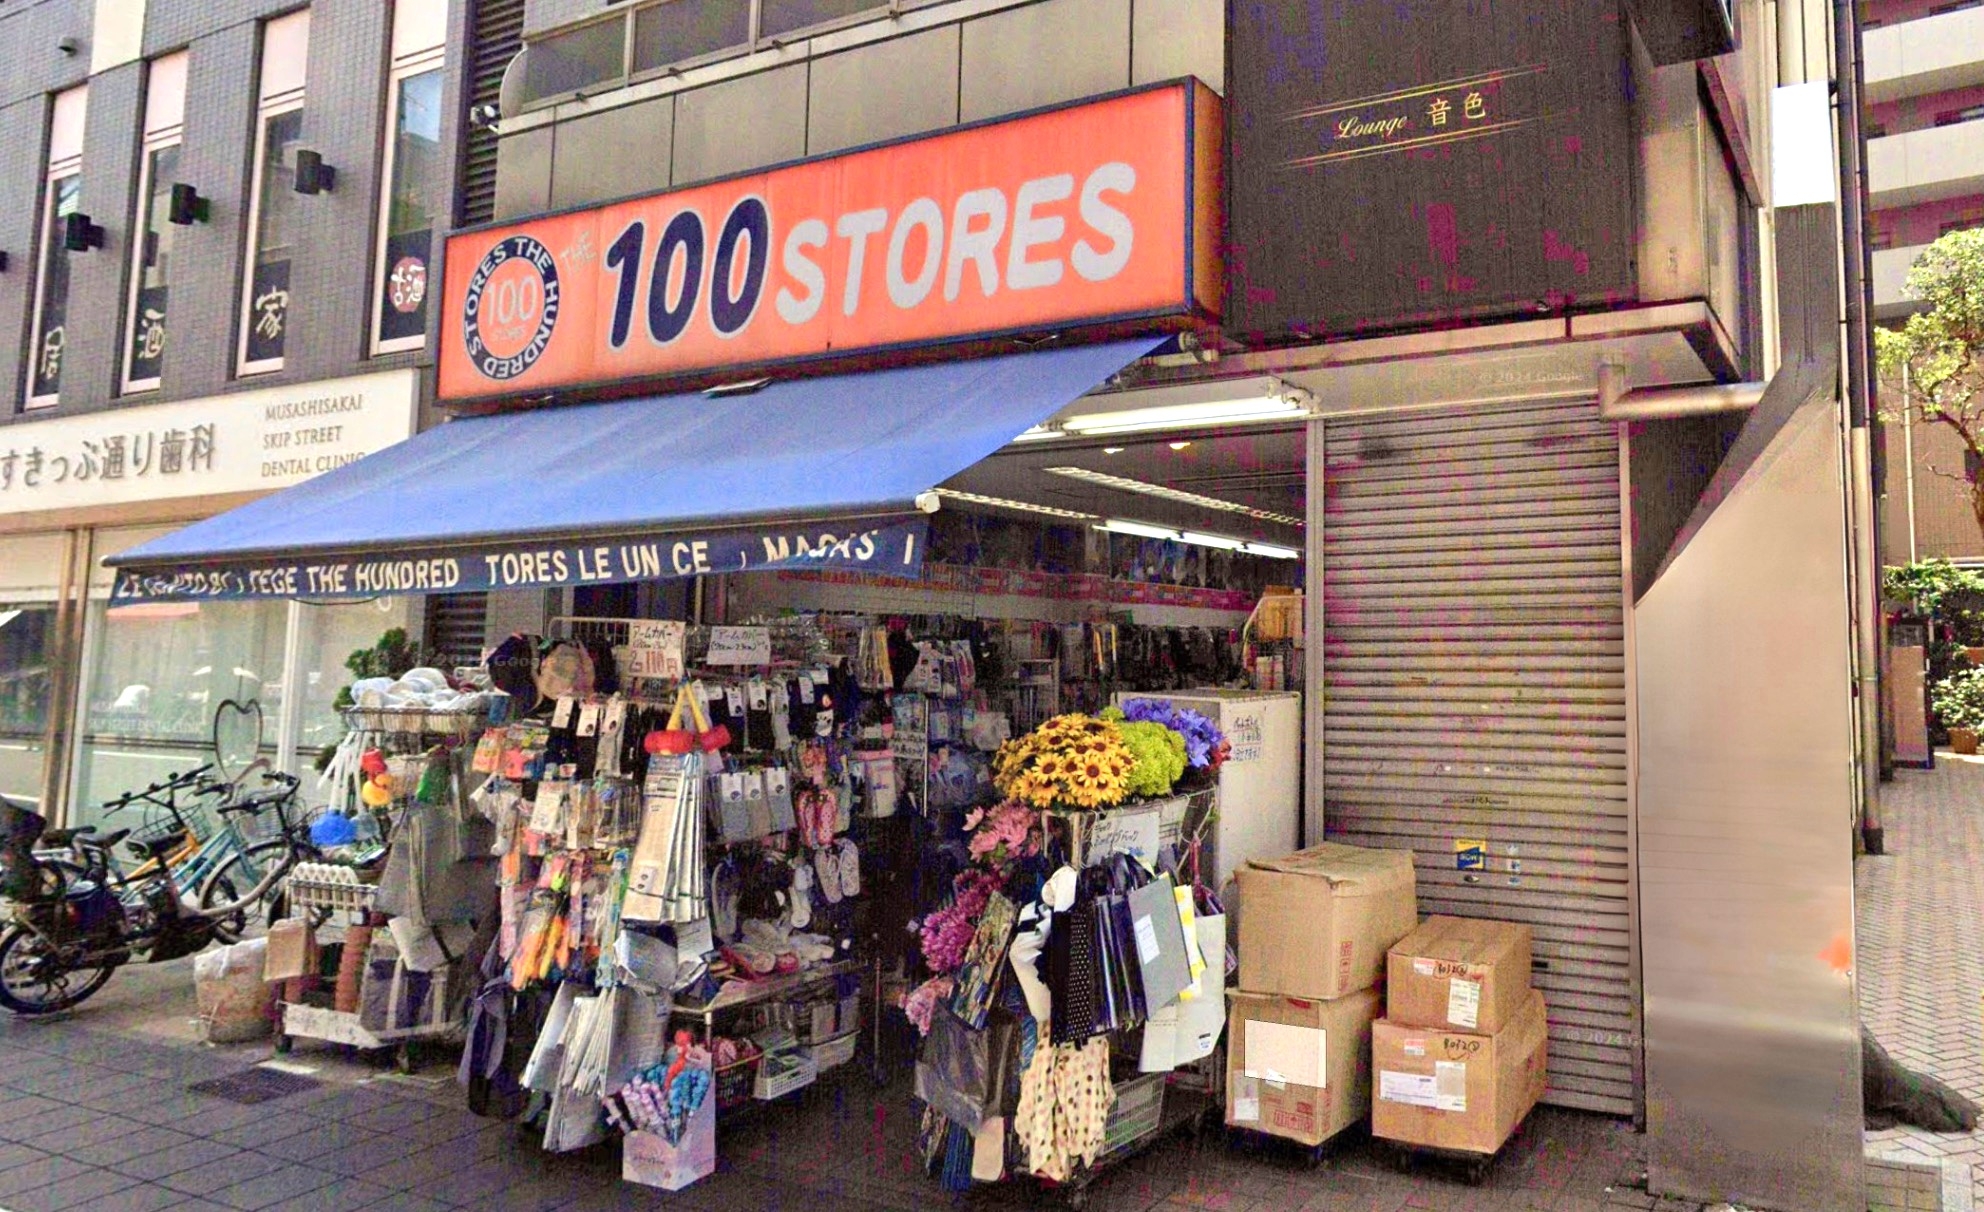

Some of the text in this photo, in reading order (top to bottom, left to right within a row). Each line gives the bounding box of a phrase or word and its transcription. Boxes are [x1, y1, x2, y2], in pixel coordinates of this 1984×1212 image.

[1338, 93, 1486, 139] Lounge 音色
[606, 195, 771, 351] 100
[777, 162, 1136, 324] STORES
[464, 237, 560, 376] THE HUNDRED STORES
[485, 275, 538, 327] 100
[264, 394, 363, 421] MUSASHISAKAI
[263, 425, 344, 450] SKIP STREET
[261, 457, 312, 478] DENTAL
[306, 563, 348, 593] THE
[355, 558, 459, 591] HUNDRED
[485, 549, 568, 585] TORES
[577, 545, 613, 580] LE
[621, 543, 661, 577] UN
[673, 540, 712, 574] CE
